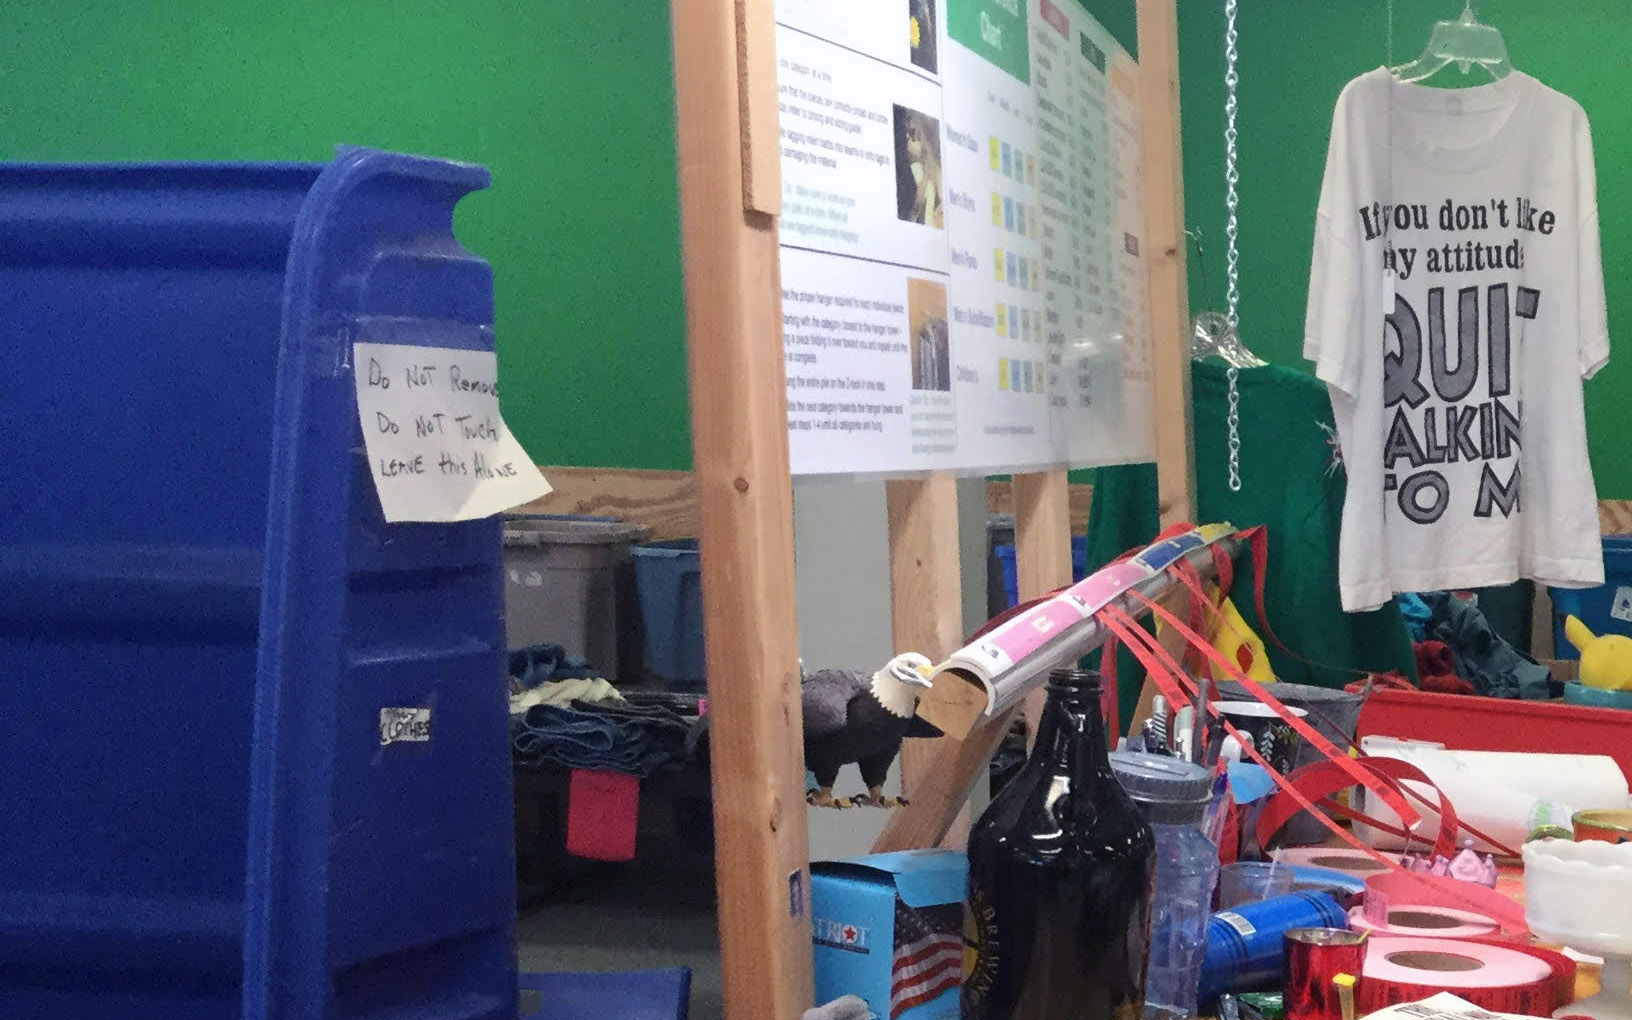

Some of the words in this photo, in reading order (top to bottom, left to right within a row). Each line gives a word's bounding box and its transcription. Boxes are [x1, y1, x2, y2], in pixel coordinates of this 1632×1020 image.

[1359, 201, 1381, 241] If
[1439, 198, 1509, 231] don't
[1516, 197, 1555, 235] lke
[369, 357, 391, 390] Do
[450, 364, 499, 397] Remov
[377, 411, 400, 435] Do
[455, 414, 499, 441] Touch
